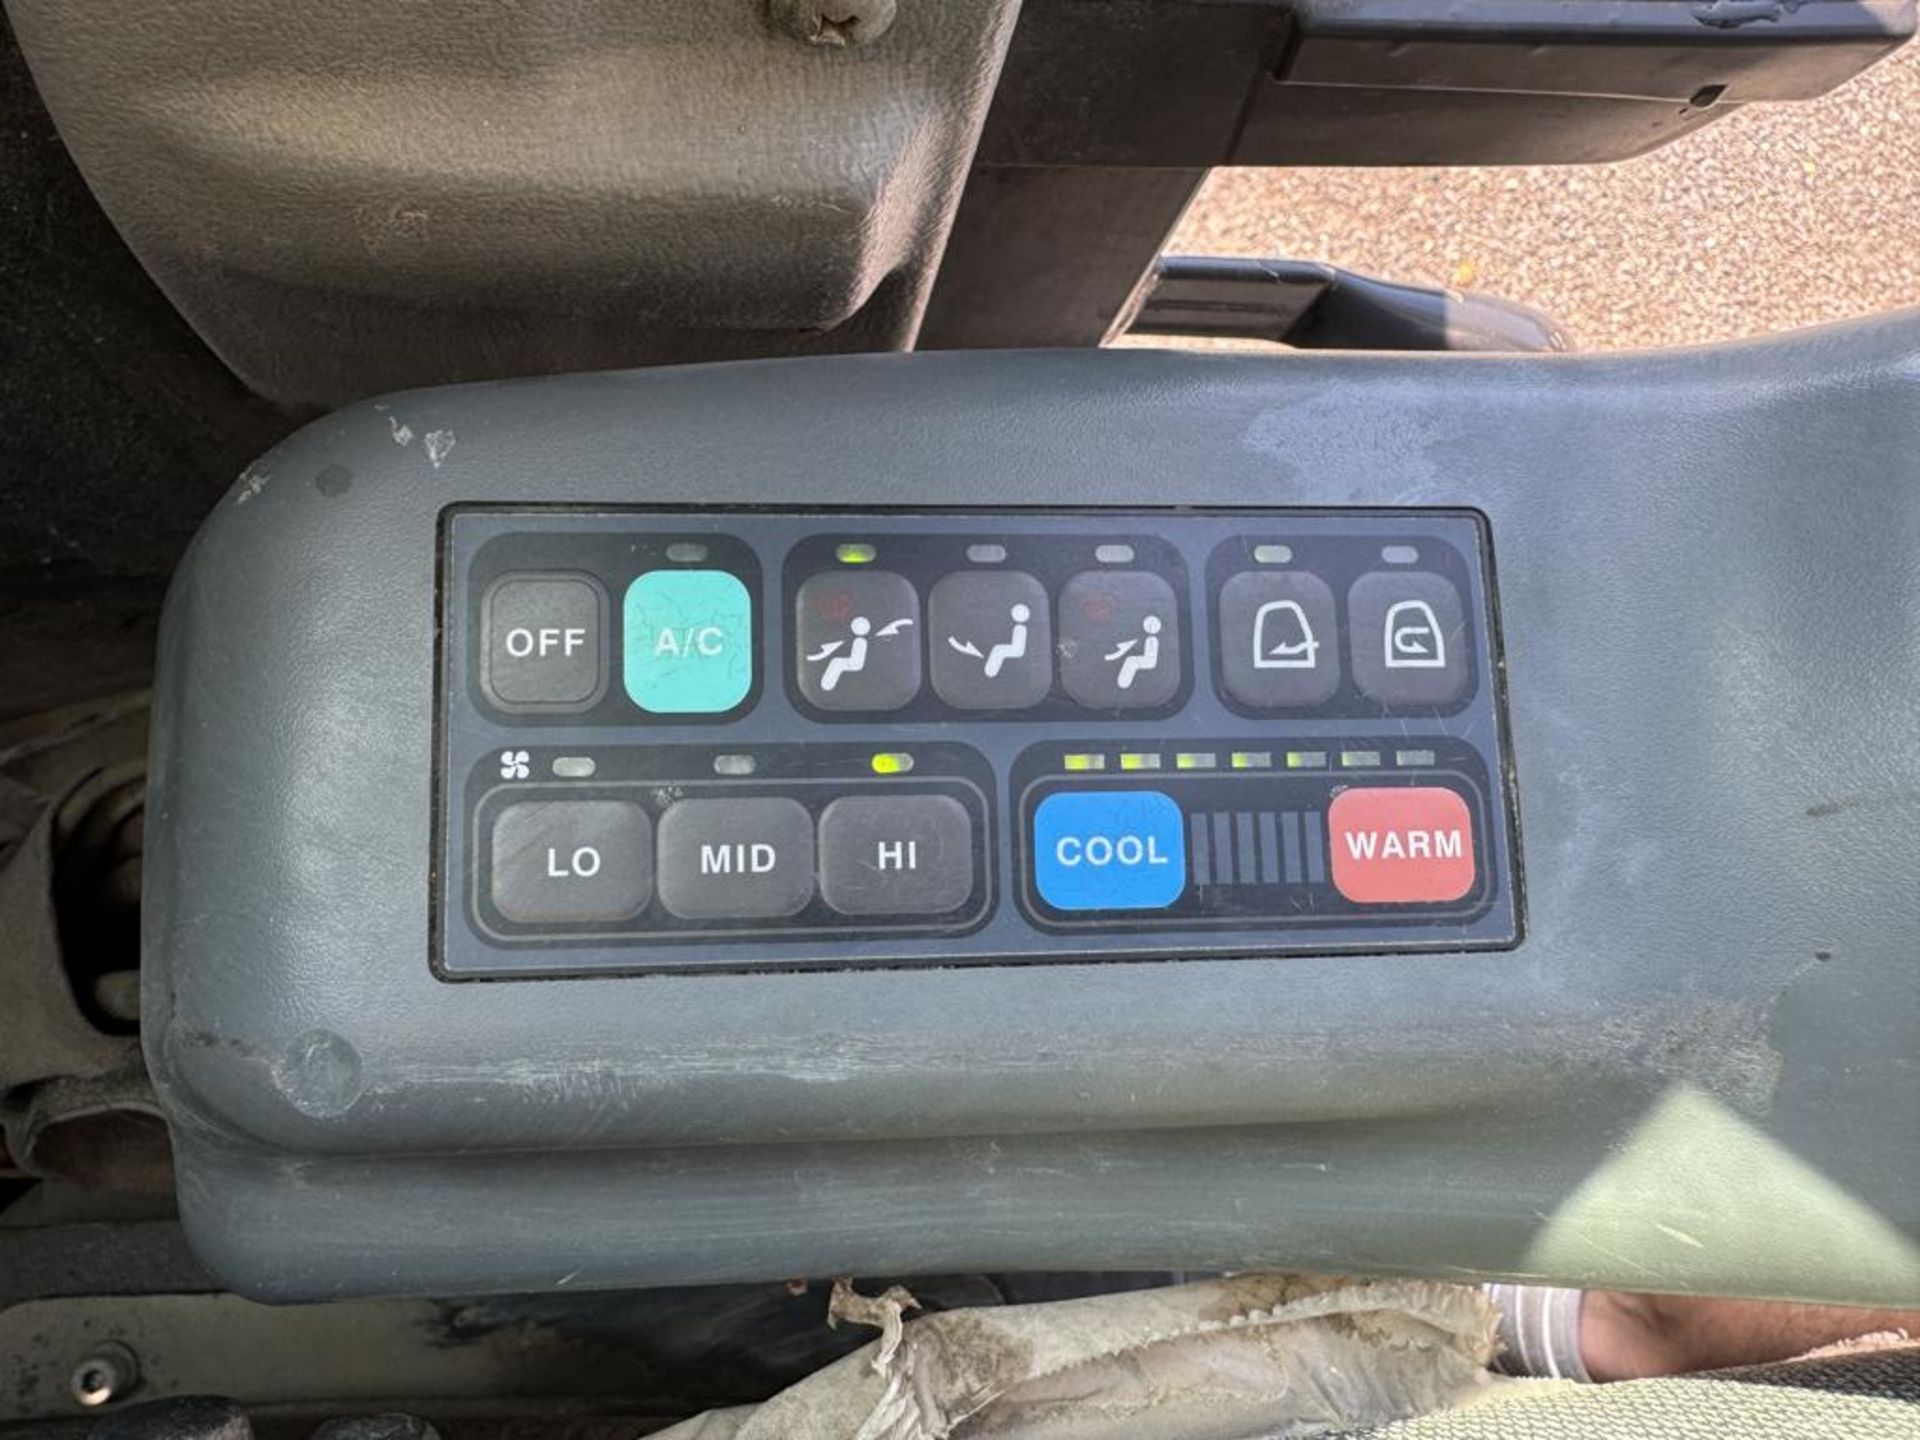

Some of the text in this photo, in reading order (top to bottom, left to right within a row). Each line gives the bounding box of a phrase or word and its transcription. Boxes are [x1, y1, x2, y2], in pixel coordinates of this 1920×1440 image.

[506, 628, 587, 657] OFF
[654, 626, 724, 656] A/C
[701, 843, 776, 874] MID
[877, 841, 916, 870] HI
[1055, 834, 1170, 867] COOL
[1345, 830, 1463, 859] WARM
[547, 846, 601, 877] LO
